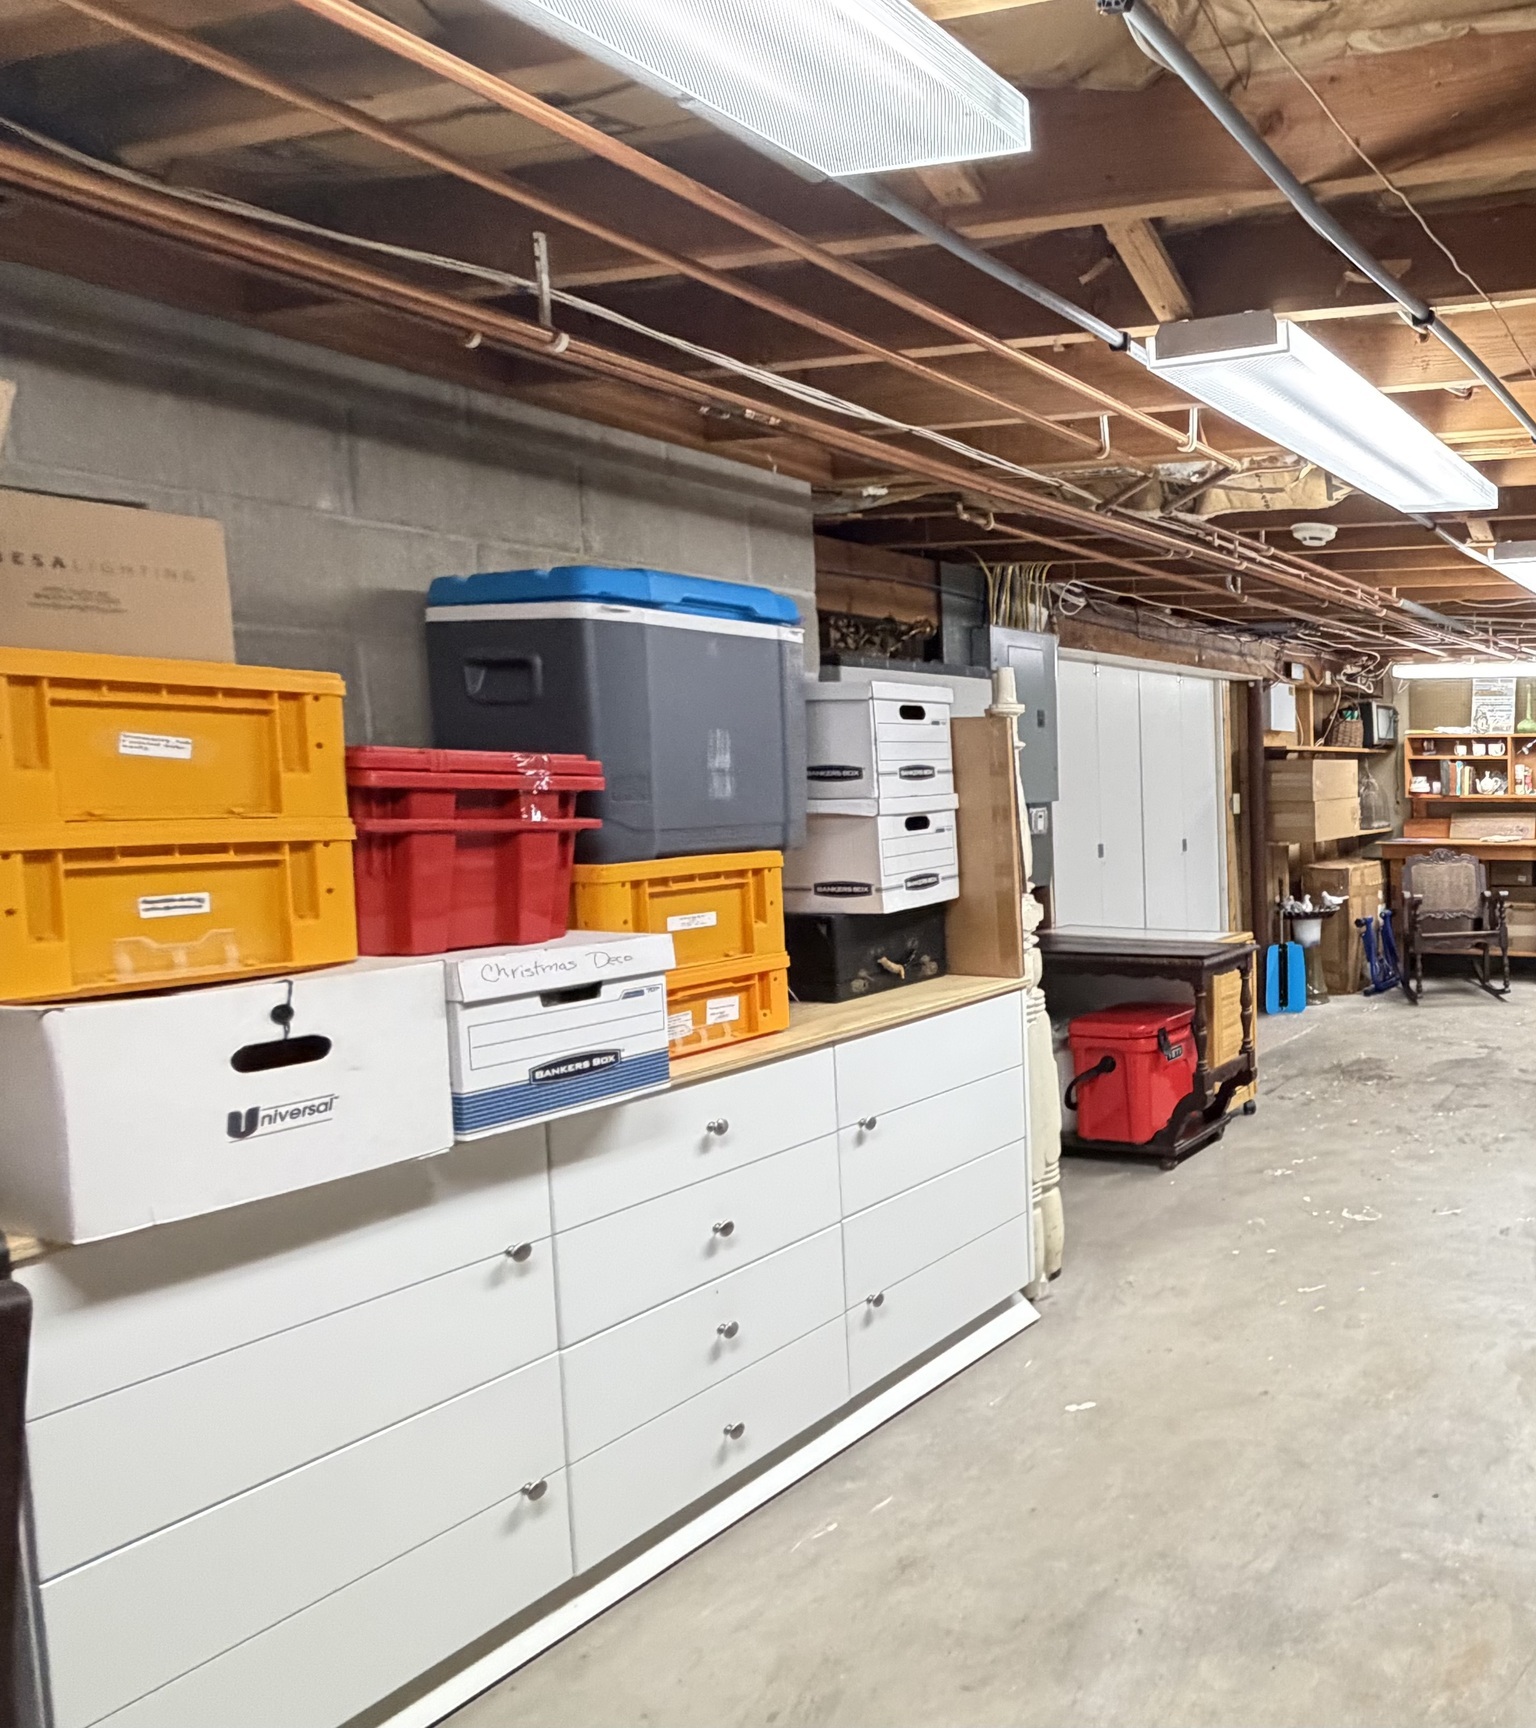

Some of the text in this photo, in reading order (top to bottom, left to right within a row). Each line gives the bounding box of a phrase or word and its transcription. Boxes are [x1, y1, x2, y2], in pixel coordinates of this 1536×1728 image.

[481, 951, 634, 982] Christmas Deco
[534, 1054, 616, 1080] BANKERS BOX
[226, 1097, 335, 1139] Universal
